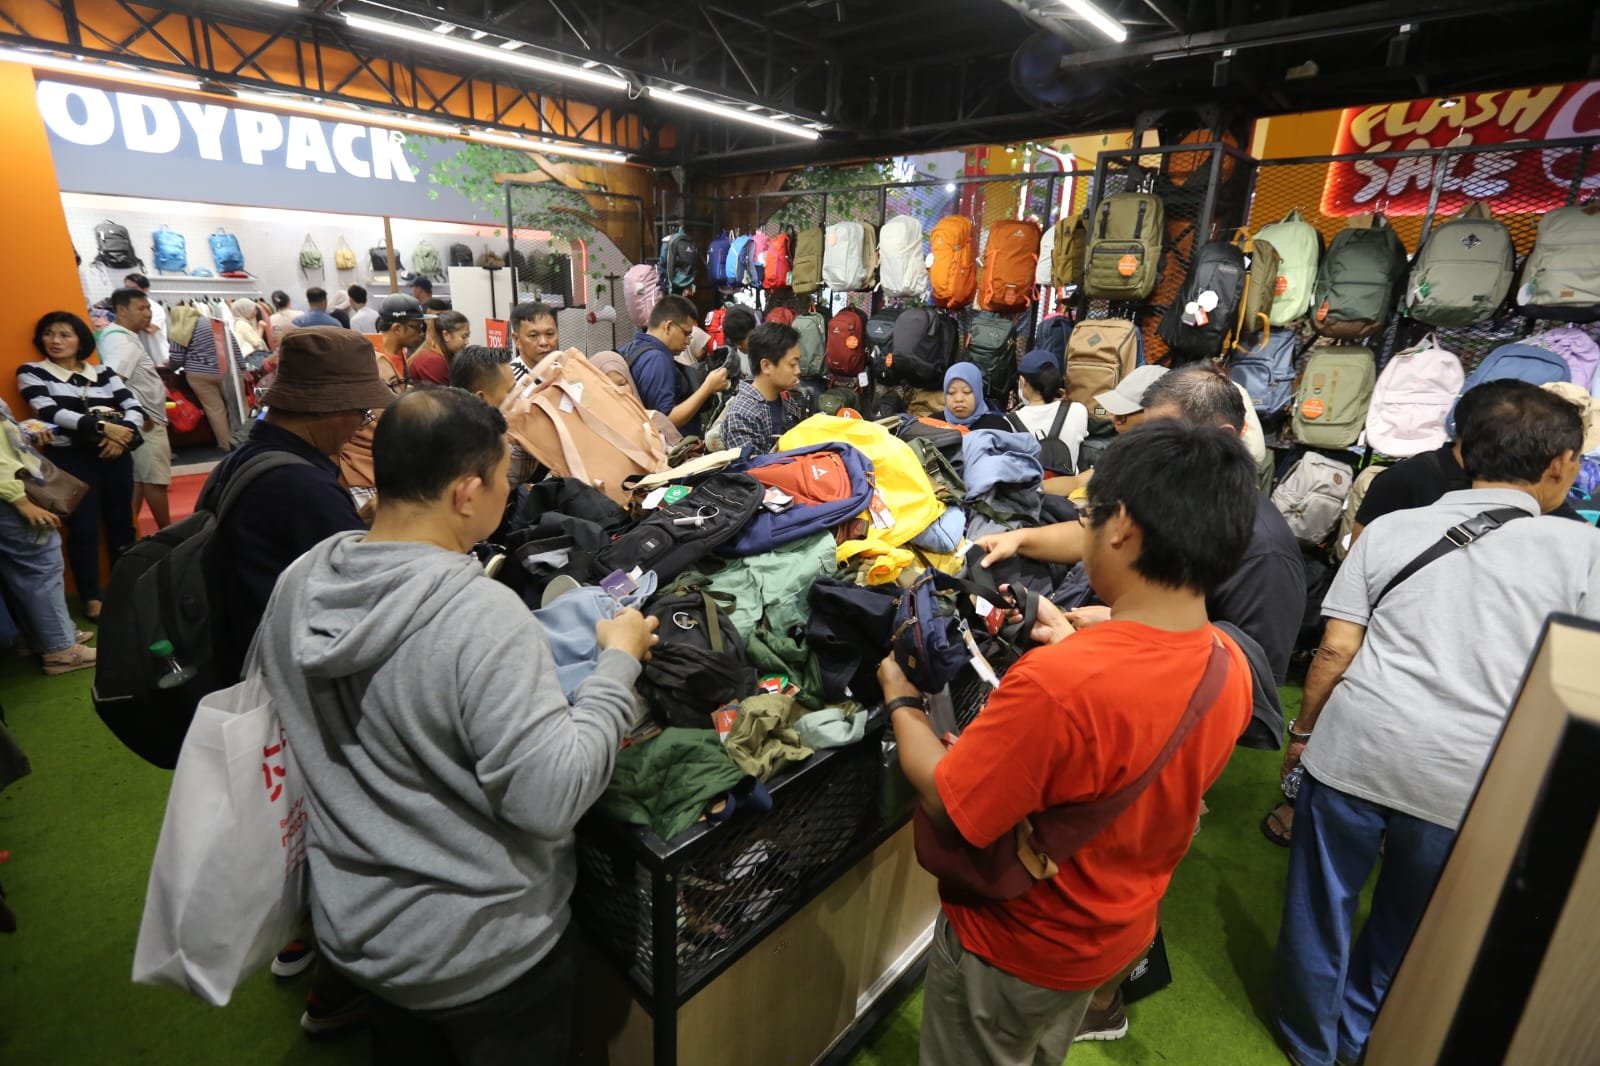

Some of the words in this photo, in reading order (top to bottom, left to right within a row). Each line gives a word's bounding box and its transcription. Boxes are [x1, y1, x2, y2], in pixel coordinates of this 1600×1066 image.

[36, 80, 416, 182] ODYPACK
[1351, 85, 1564, 147] FLASH
[1353, 133, 1529, 203] SALE
